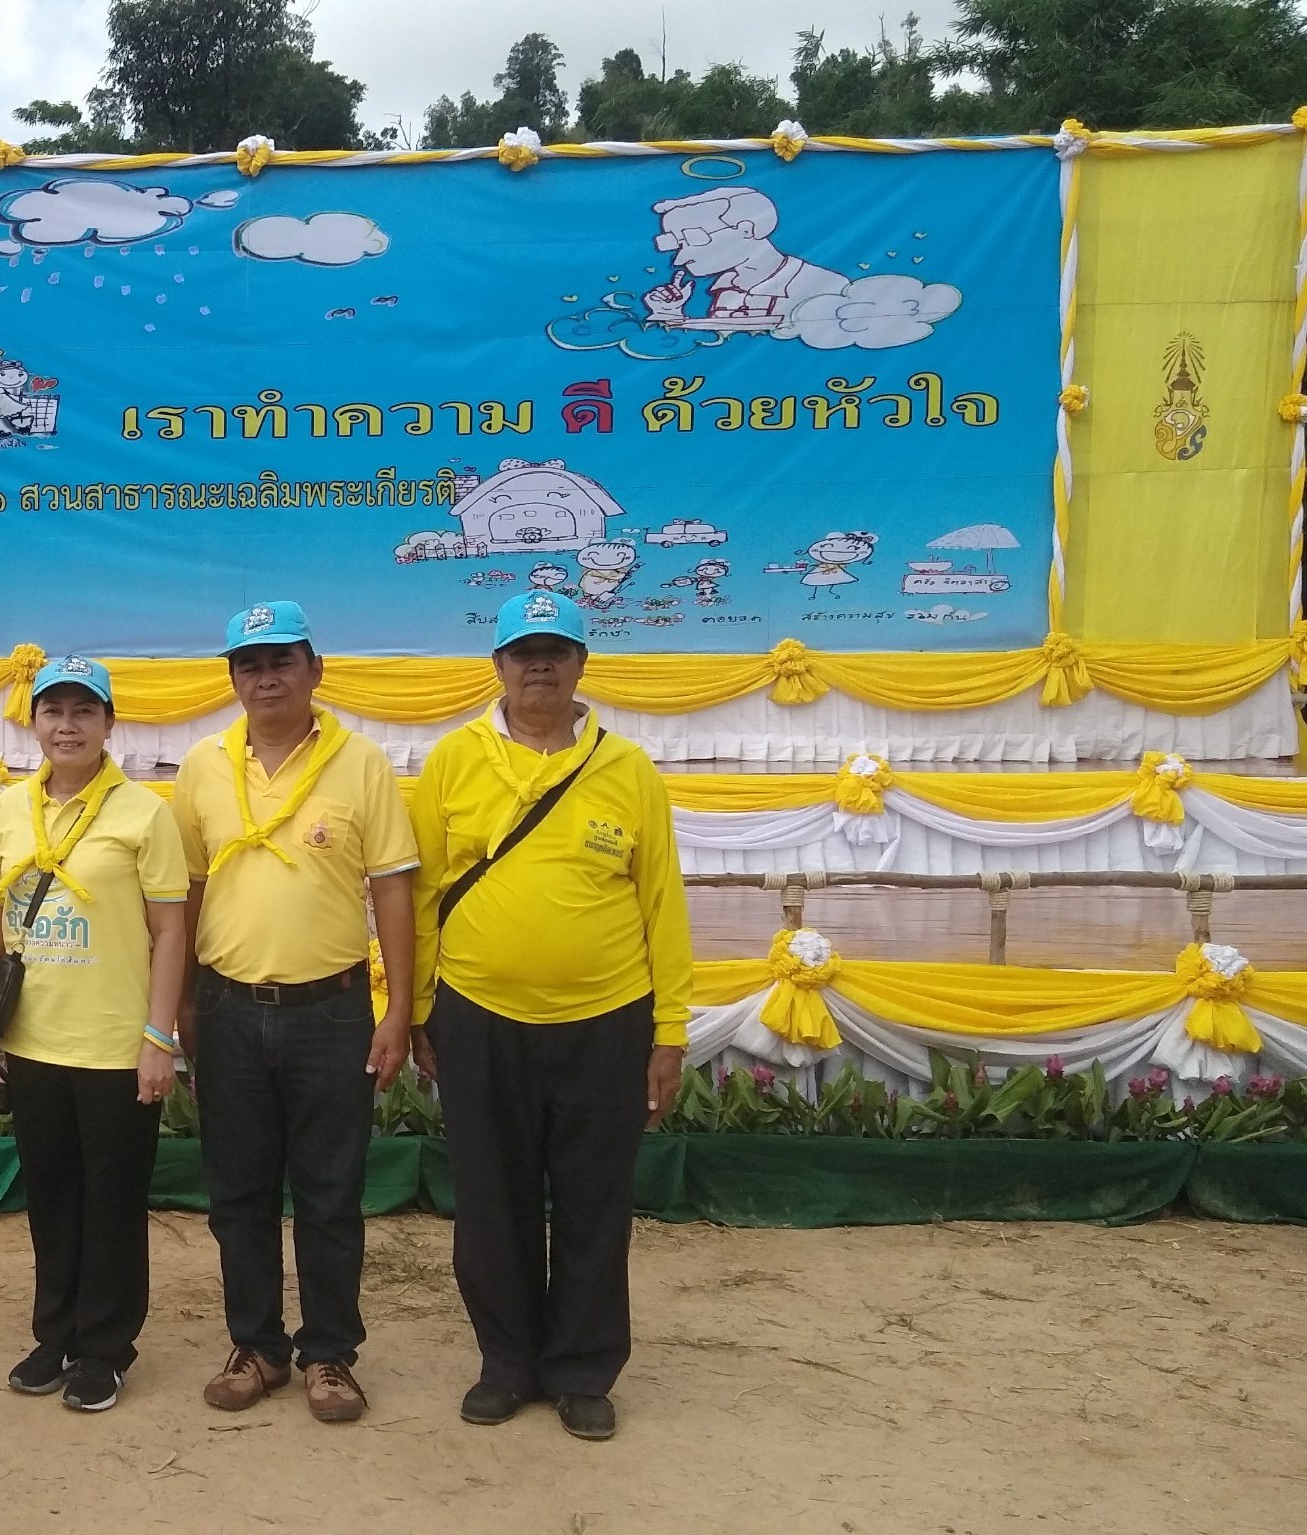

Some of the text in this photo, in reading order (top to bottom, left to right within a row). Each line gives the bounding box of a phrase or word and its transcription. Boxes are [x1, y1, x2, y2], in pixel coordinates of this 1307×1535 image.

[121, 371, 1001, 440] เราทำความ ดี ด้วยหัวใจ
[19, 467, 459, 512] สวนสาธารณะเฉลิมพระเกียรติ
